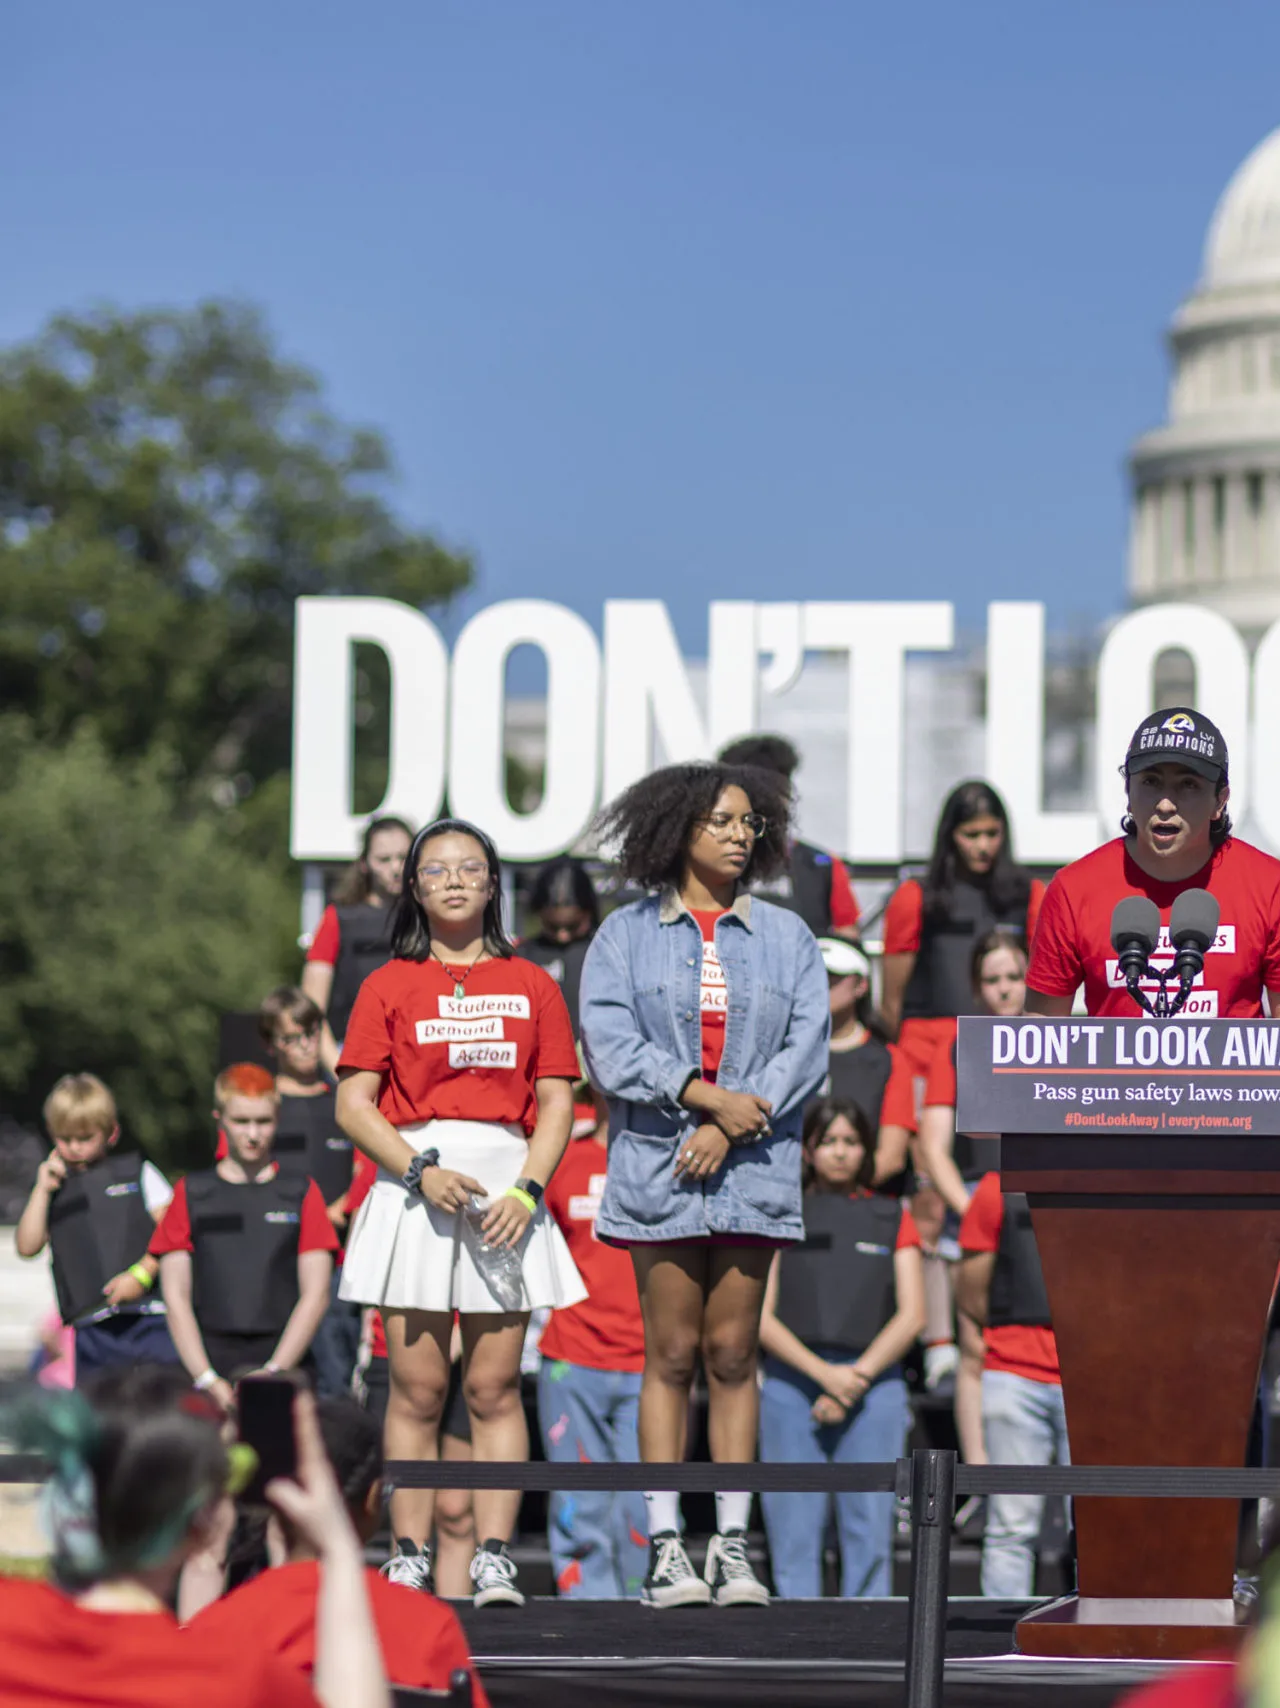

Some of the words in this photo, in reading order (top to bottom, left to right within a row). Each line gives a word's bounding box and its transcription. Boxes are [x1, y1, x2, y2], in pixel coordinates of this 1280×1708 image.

[290, 596, 955, 862] DON'T
[1140, 734, 1215, 757] CHAMPIONS
[447, 1000, 522, 1014] Students
[425, 1021, 496, 1038] Demand
[456, 1047, 511, 1063] Action
[992, 1025, 1104, 1065] DON'T
[1115, 1025, 1213, 1066] LOOK
[1033, 1083, 1076, 1100] Pass
[1081, 1087, 1120, 1105] gun
[1124, 1082, 1184, 1105] safety
[1188, 1083, 1232, 1101] laws
[1065, 1112, 1159, 1129] #DontLookAway
[1168, 1114, 1252, 1131] everytown.org
